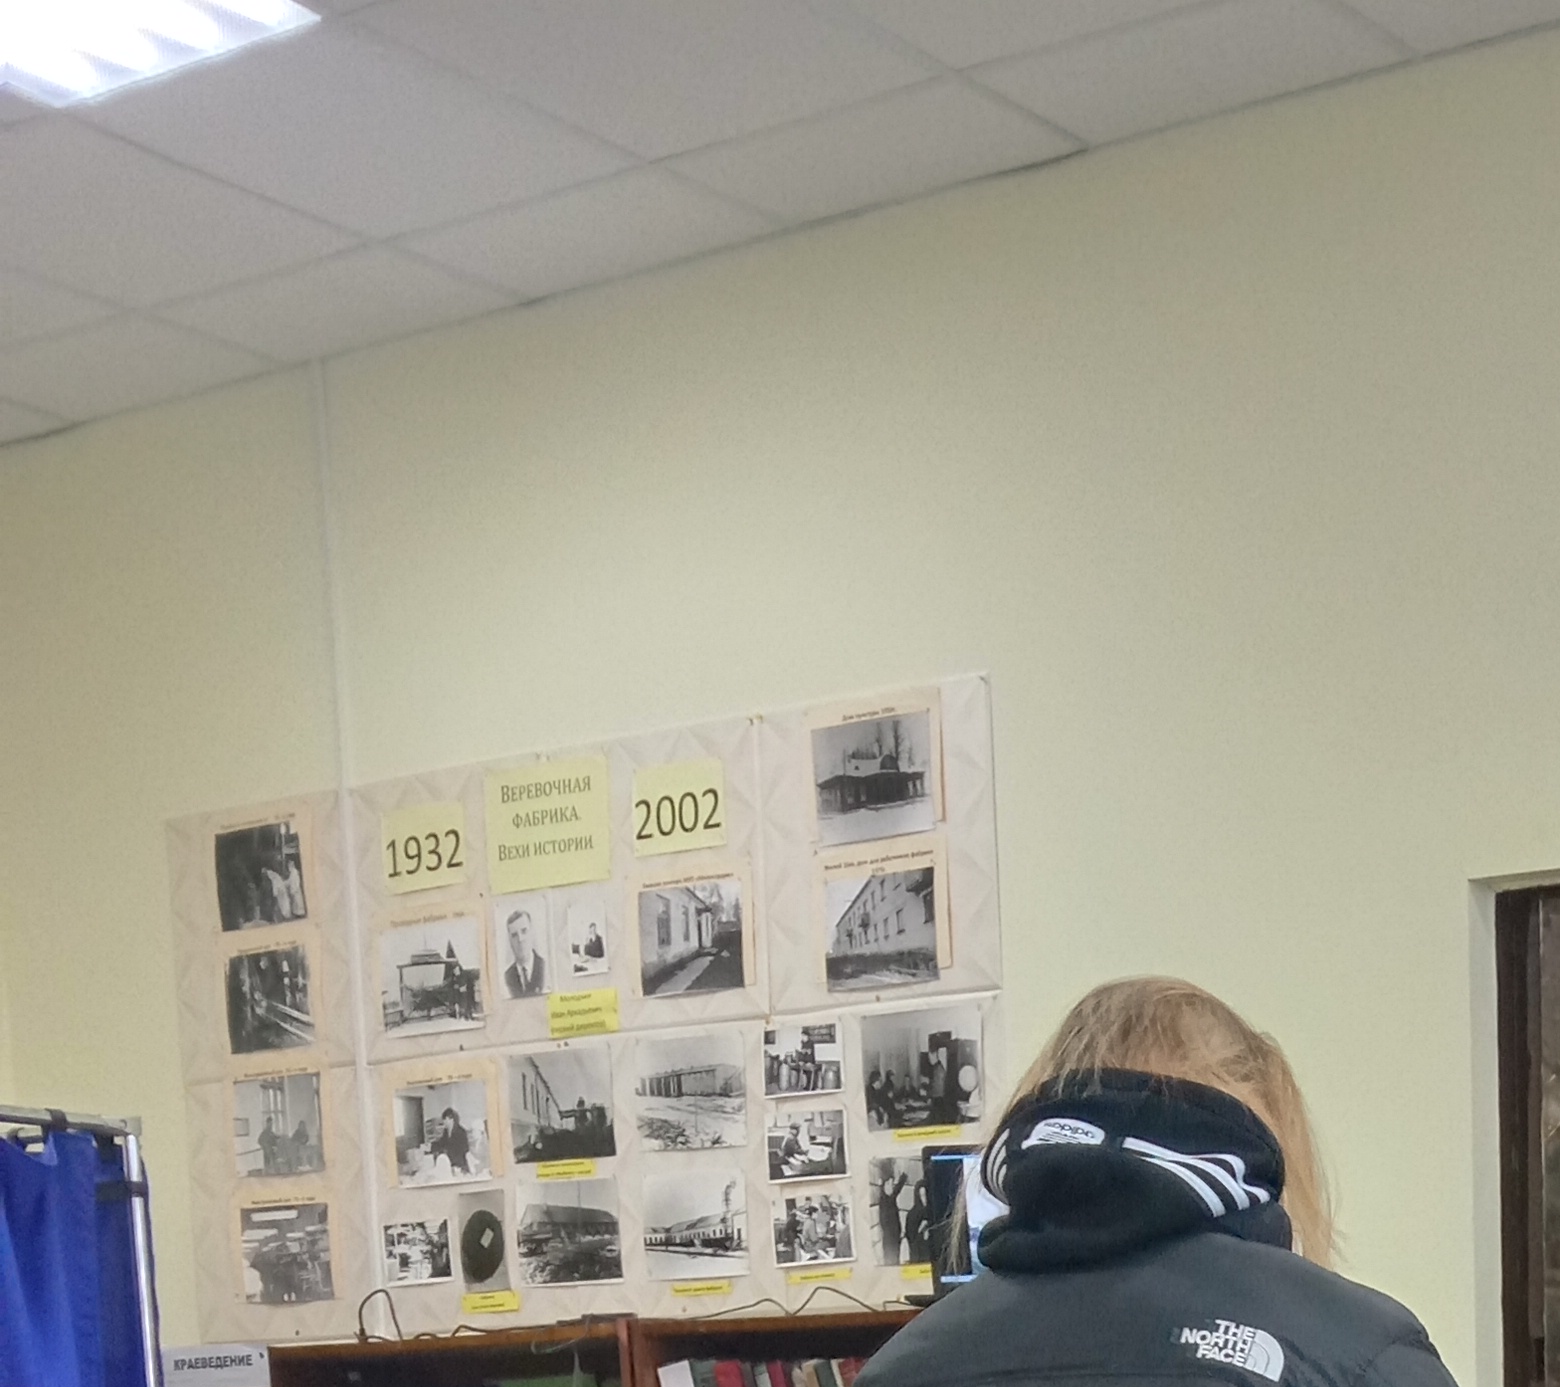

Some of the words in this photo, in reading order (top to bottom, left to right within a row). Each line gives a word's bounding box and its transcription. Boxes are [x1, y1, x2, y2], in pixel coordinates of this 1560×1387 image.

[500, 775, 592, 804] ВЕРЕВОЧНАЯ
[634, 787, 723, 841] 2002
[386, 828, 464, 879] 1932
[497, 843, 531, 862] ВЕХИ
[533, 834, 595, 857] ИСТОРИИ
[1180, 1326, 1255, 1354] NORTH
[1214, 1318, 1257, 1341] THE
[173, 1353, 254, 1371] КРАЕВЕДЕНИЕ
[1196, 1343, 1248, 1368] FACE
